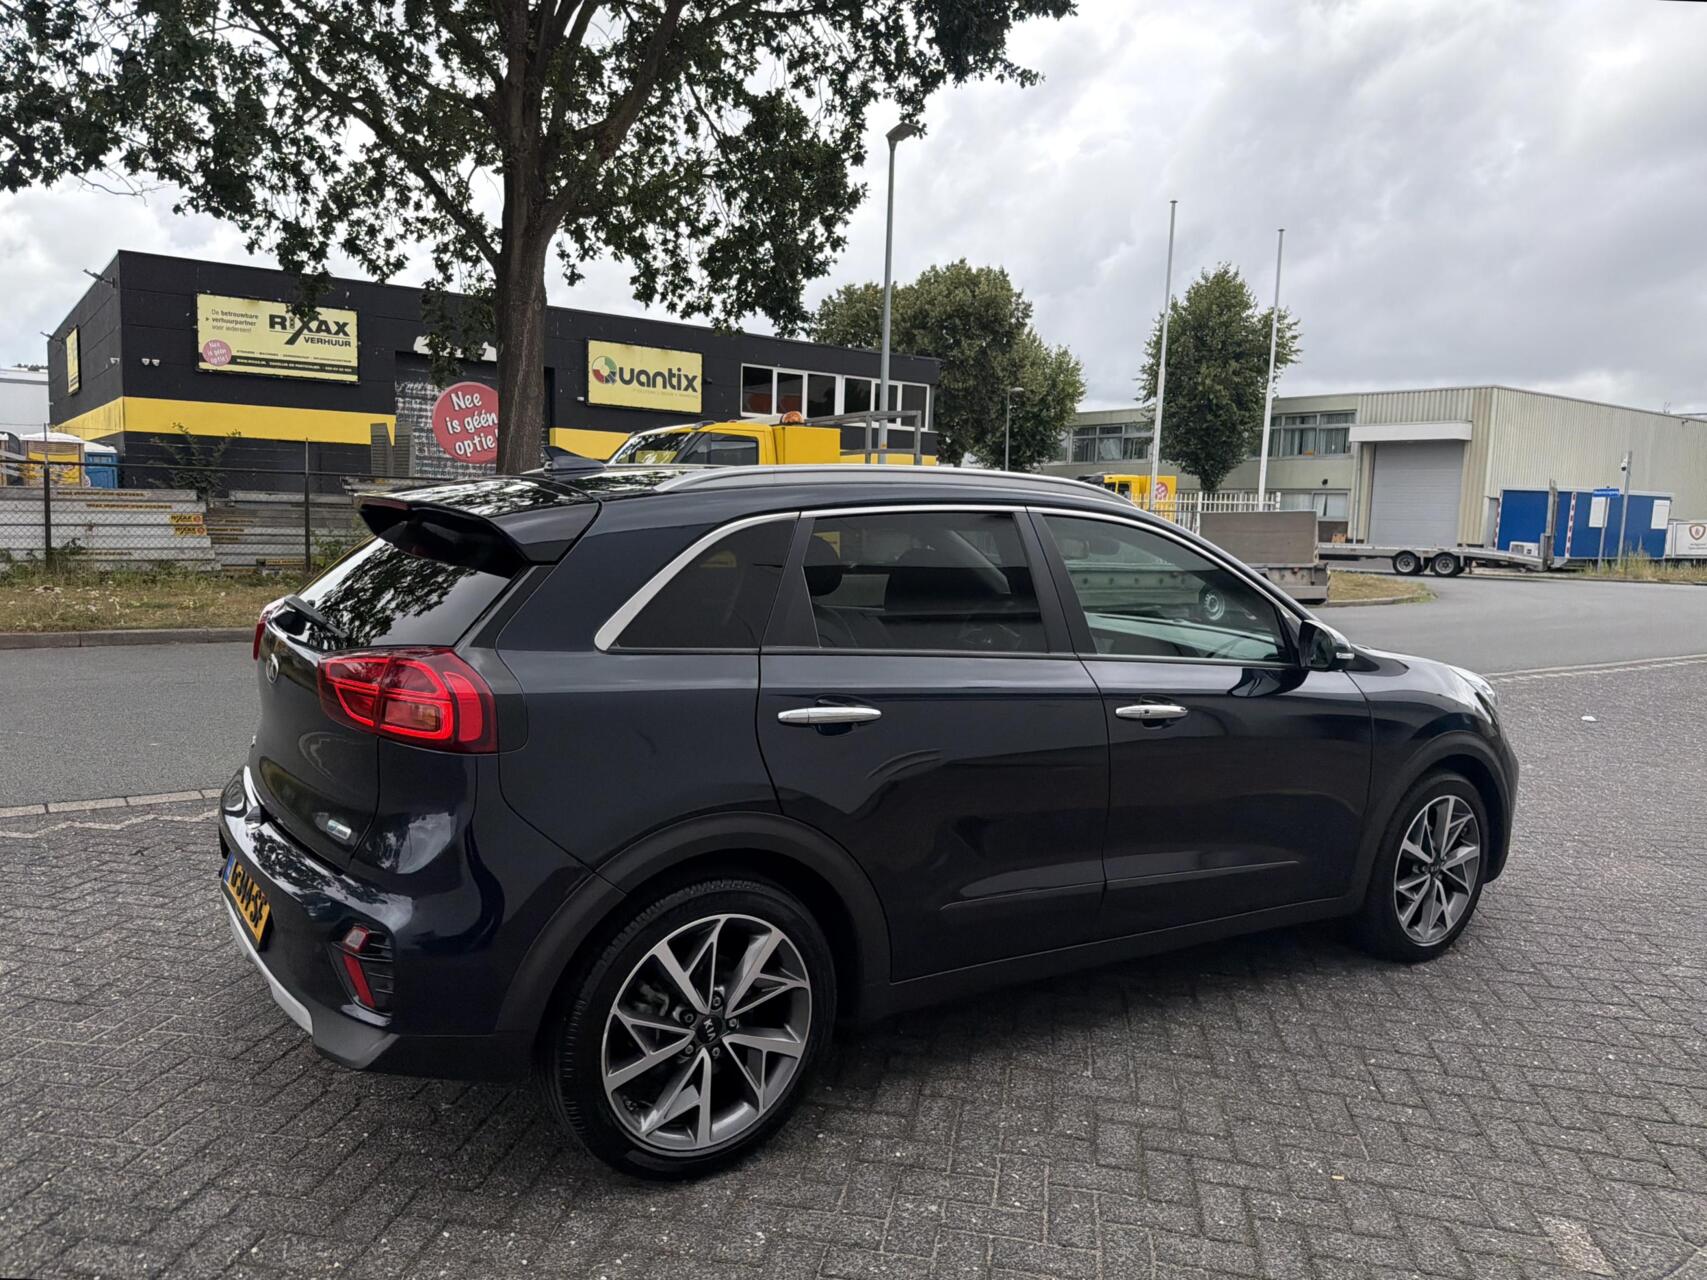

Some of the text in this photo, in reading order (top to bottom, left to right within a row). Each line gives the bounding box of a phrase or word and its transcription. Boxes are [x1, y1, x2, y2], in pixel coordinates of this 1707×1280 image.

[221, 310, 259, 319] betrouwbare
[304, 336, 351, 347] VERHUUR
[592, 356, 698, 393] Quantix
[451, 391, 482, 411] Nee
[446, 409, 498, 434] is géén
[704, 1018, 716, 1041] KIA
